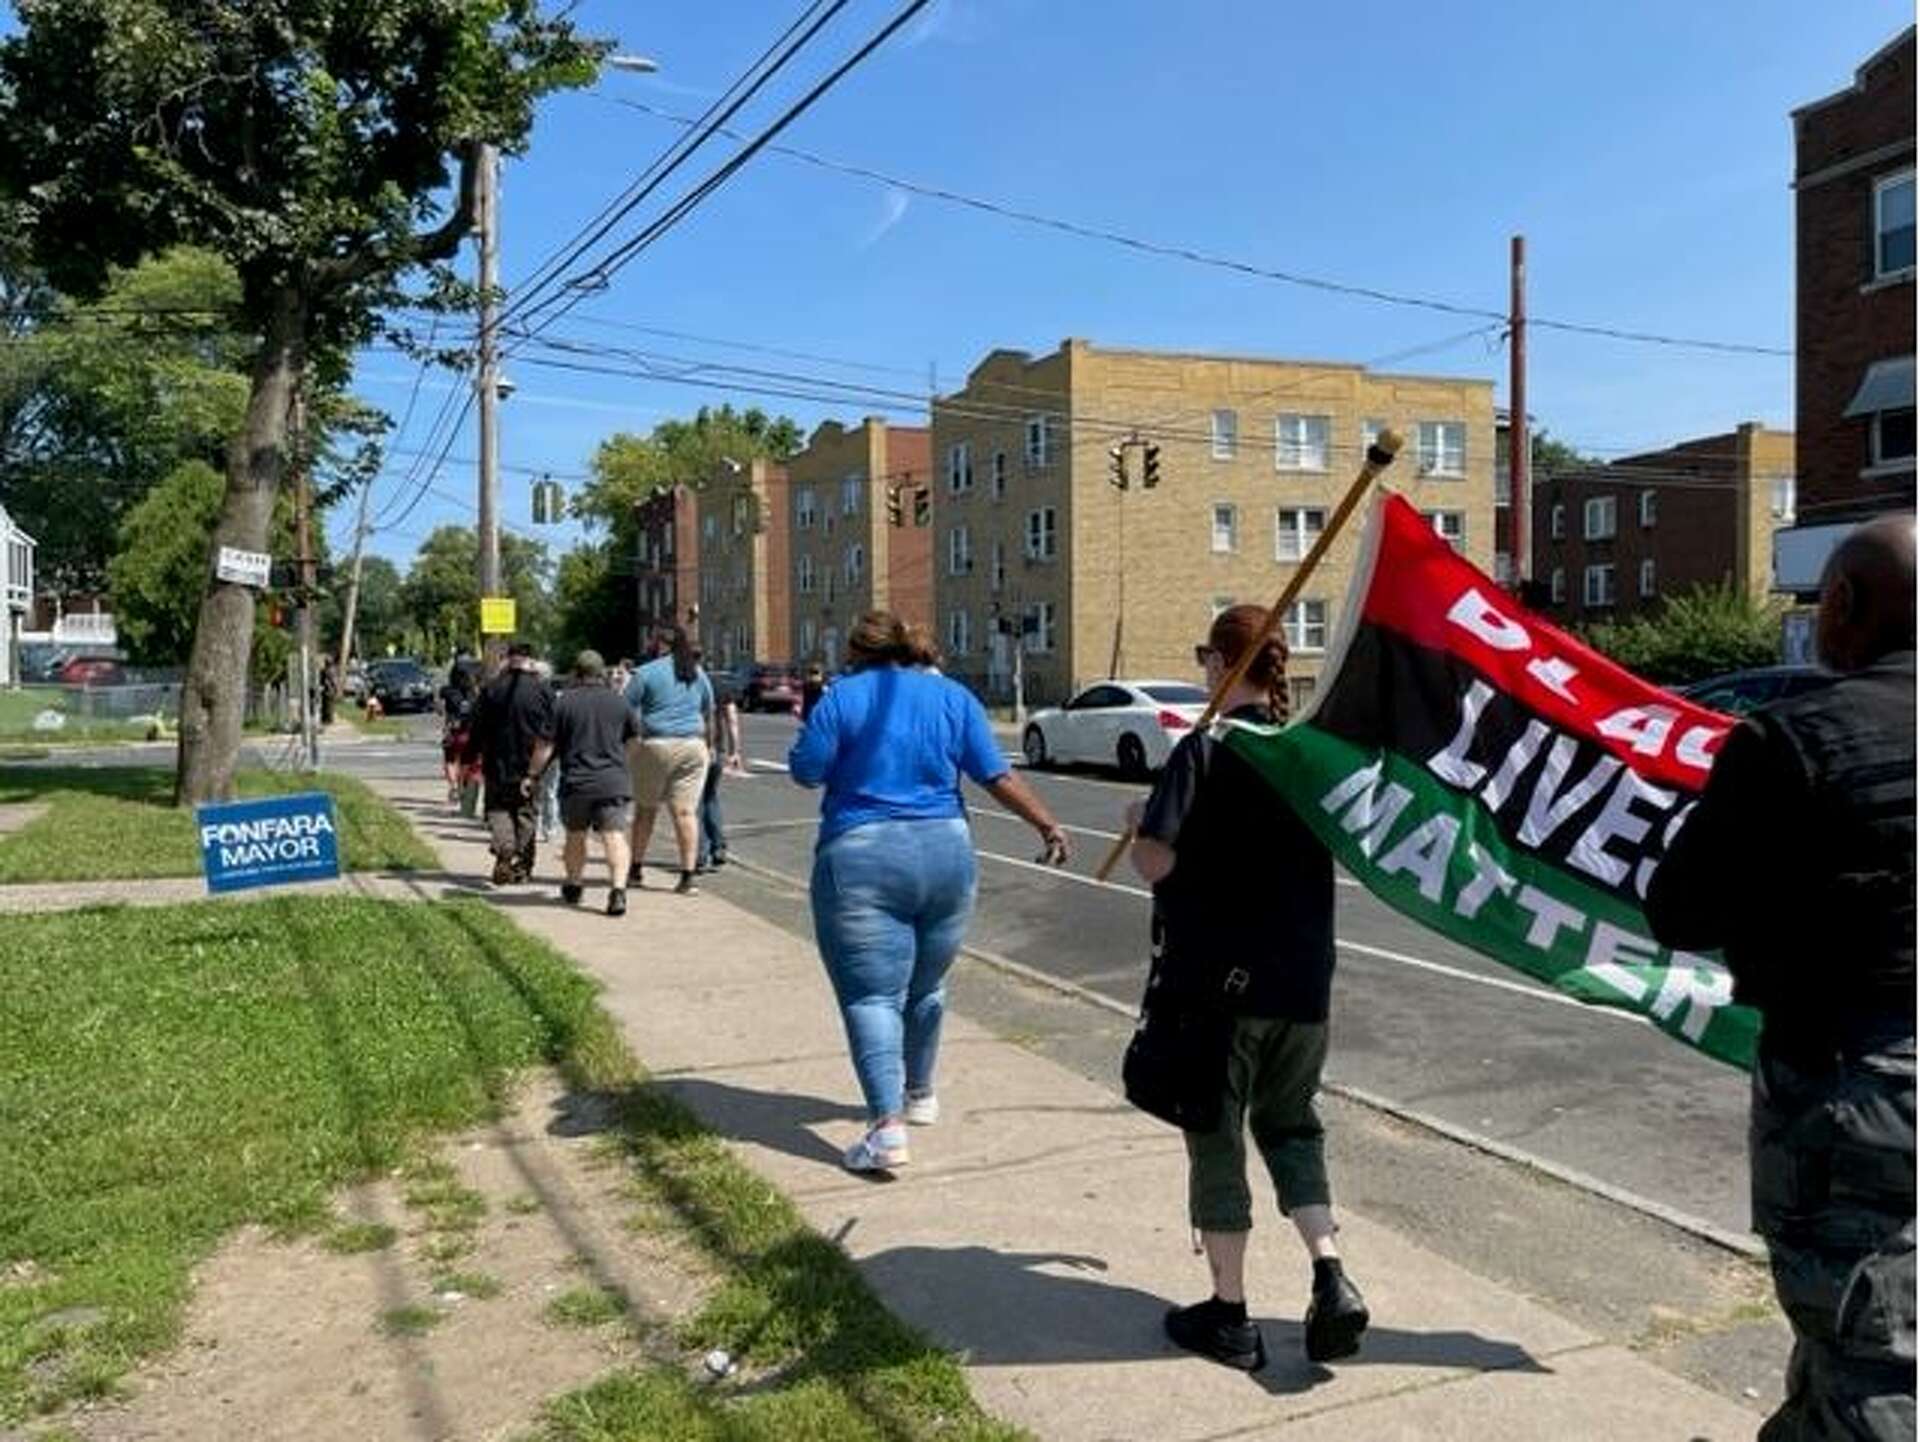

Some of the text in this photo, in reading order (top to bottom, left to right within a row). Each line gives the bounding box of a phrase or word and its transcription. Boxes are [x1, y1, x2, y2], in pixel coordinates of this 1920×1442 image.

[201, 813, 333, 848] FONFARA
[220, 836, 319, 867] MAYOR
[1321, 758, 1734, 1043] MATTER
